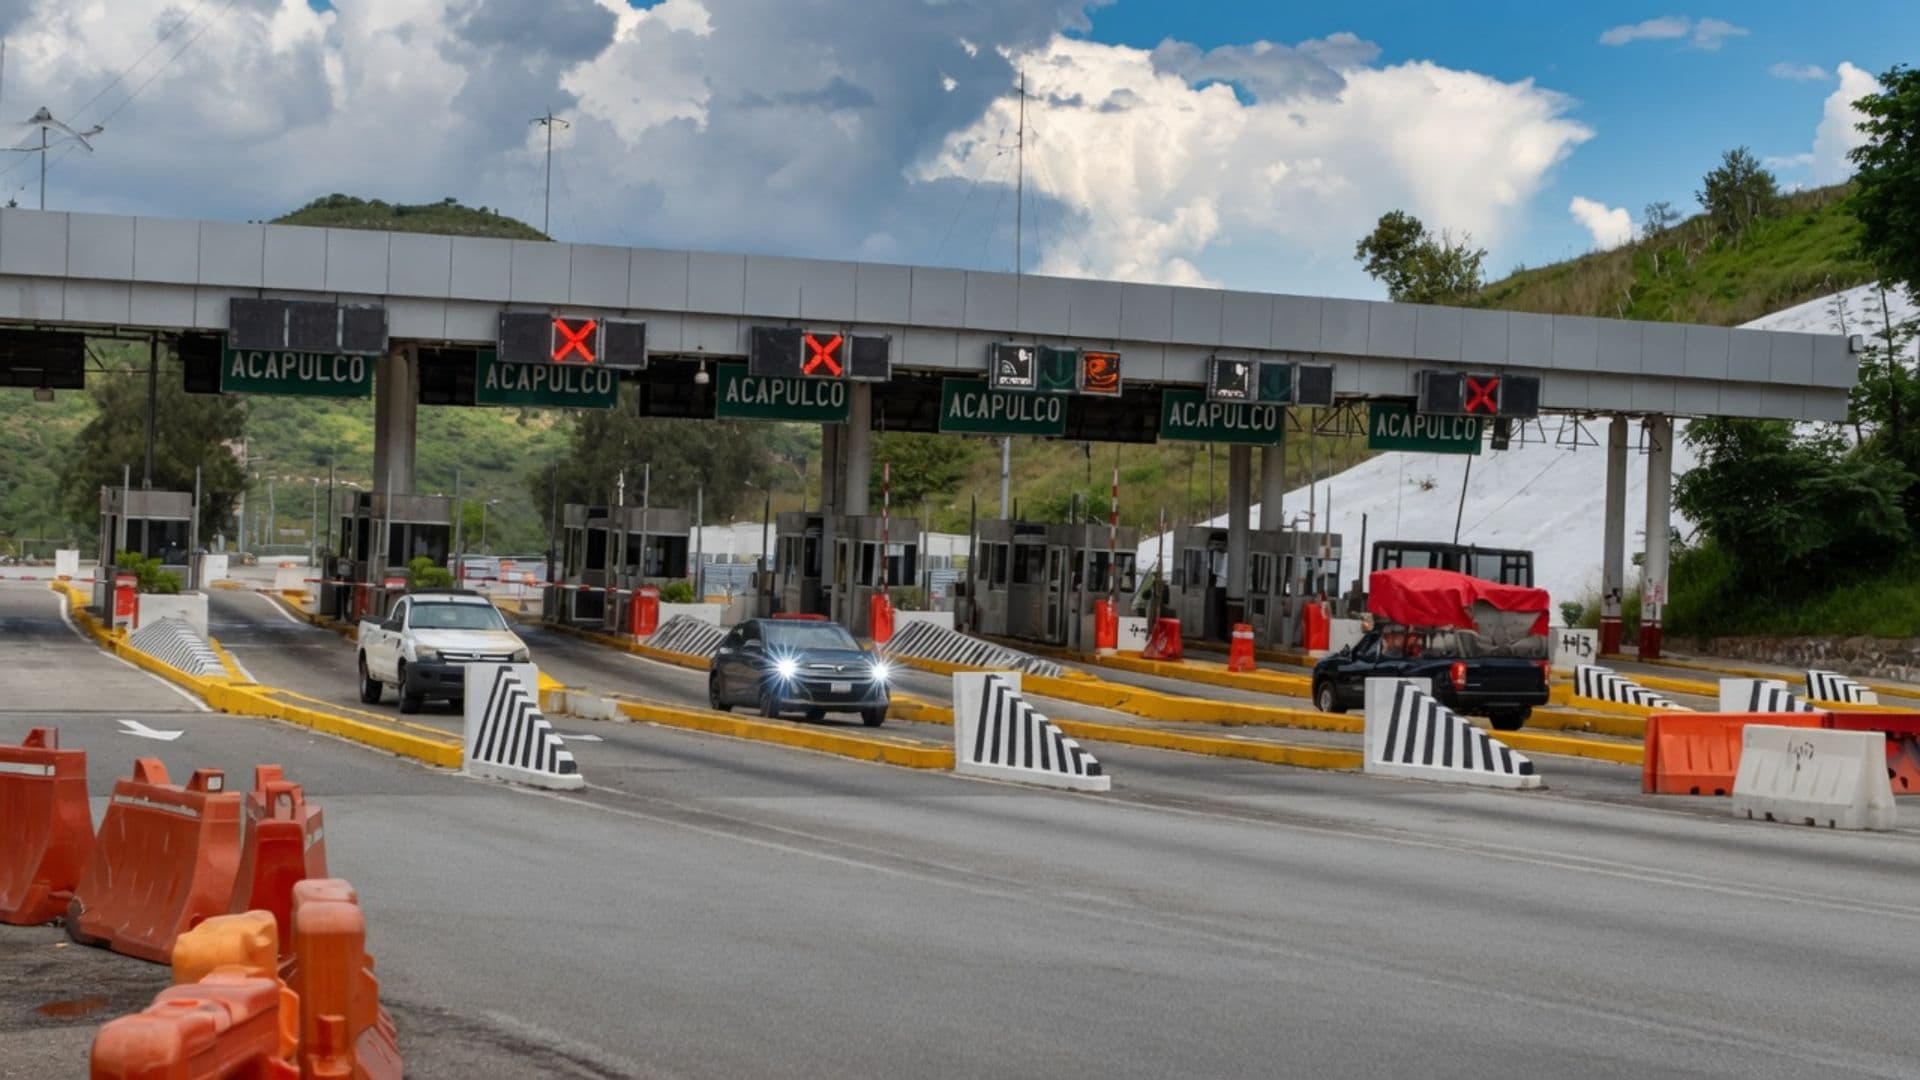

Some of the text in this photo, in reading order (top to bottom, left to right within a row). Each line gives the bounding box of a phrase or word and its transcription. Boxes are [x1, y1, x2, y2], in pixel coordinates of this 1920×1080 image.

[231, 351, 365, 383] ACAPULCO
[485, 362, 611, 394] ACAPULCO
[726, 376, 844, 407] ACAPULCO
[949, 392, 1060, 422] ACAPULCO
[1169, 401, 1276, 430] ACAPULCO
[1376, 413, 1476, 440] ACAPULCO
